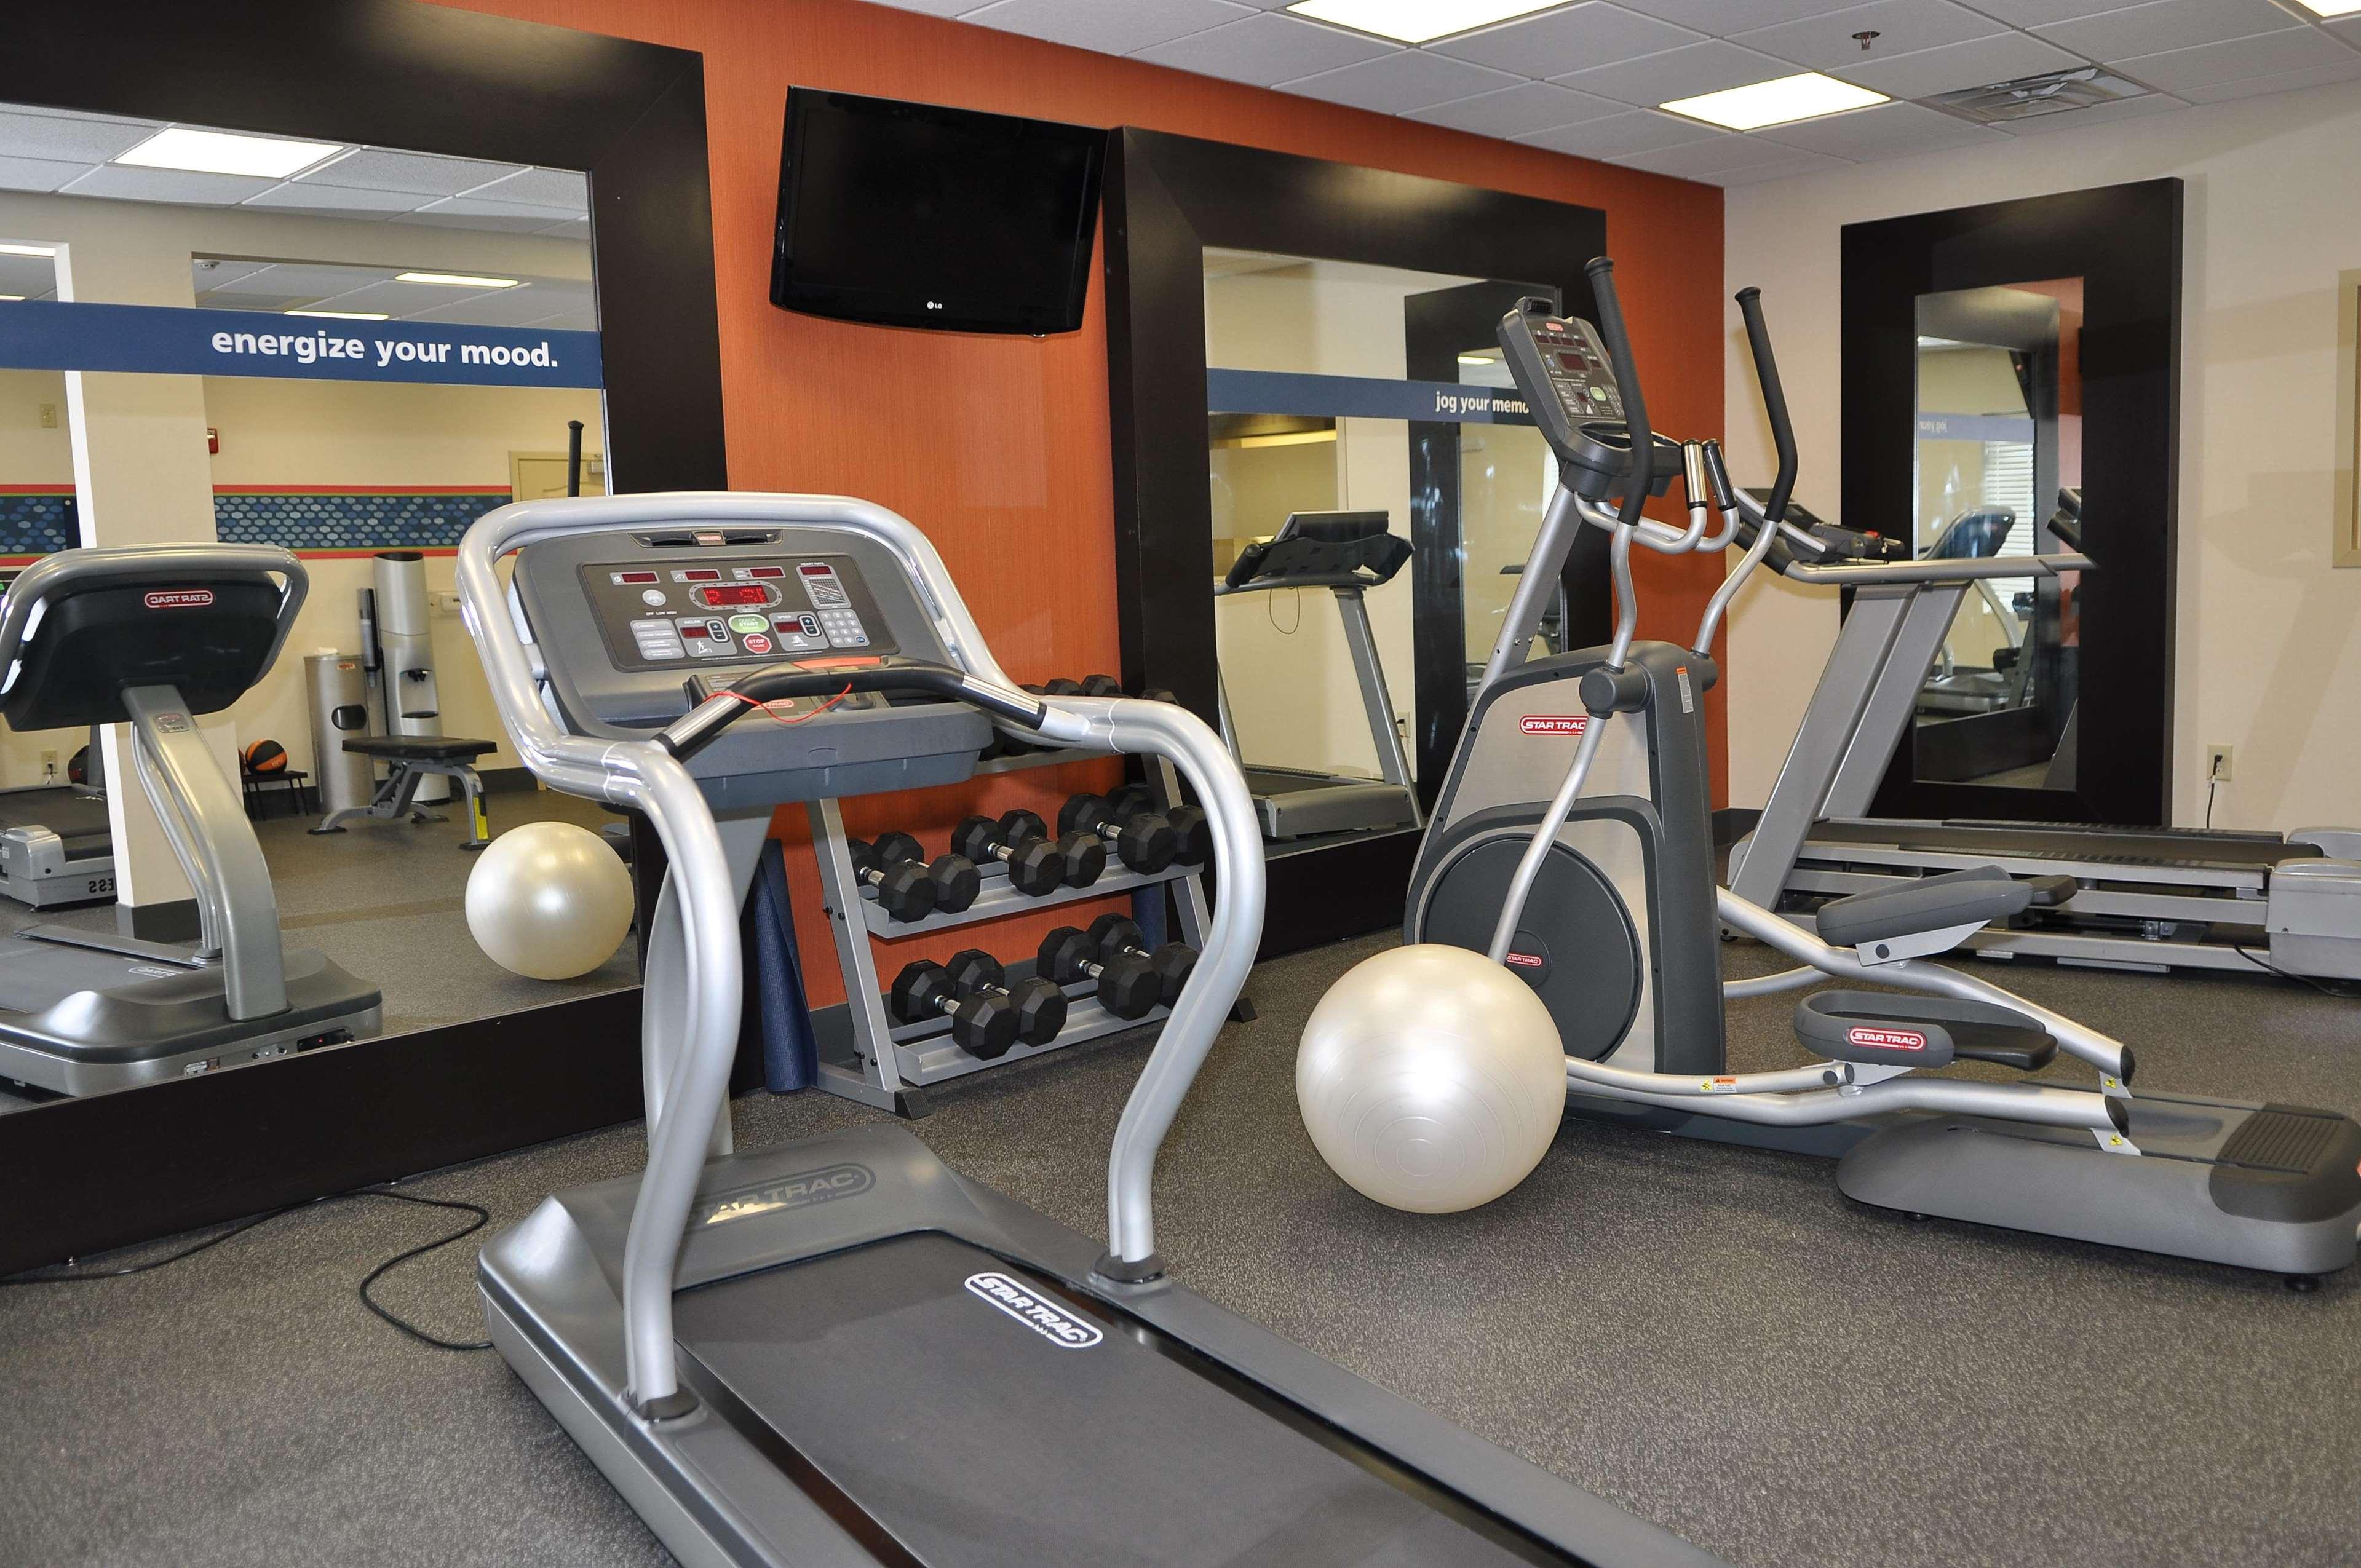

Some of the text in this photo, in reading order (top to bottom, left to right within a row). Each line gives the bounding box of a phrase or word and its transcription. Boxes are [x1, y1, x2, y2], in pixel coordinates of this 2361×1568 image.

[211, 330, 558, 368] energize your mood.
[1435, 390, 1458, 414] jog
[1460, 396, 1490, 414] your
[1853, 1032, 1918, 1045] STAR TRAC
[764, 1173, 854, 1203] TRAC
[978, 1278, 1088, 1342] STAR TRAC
